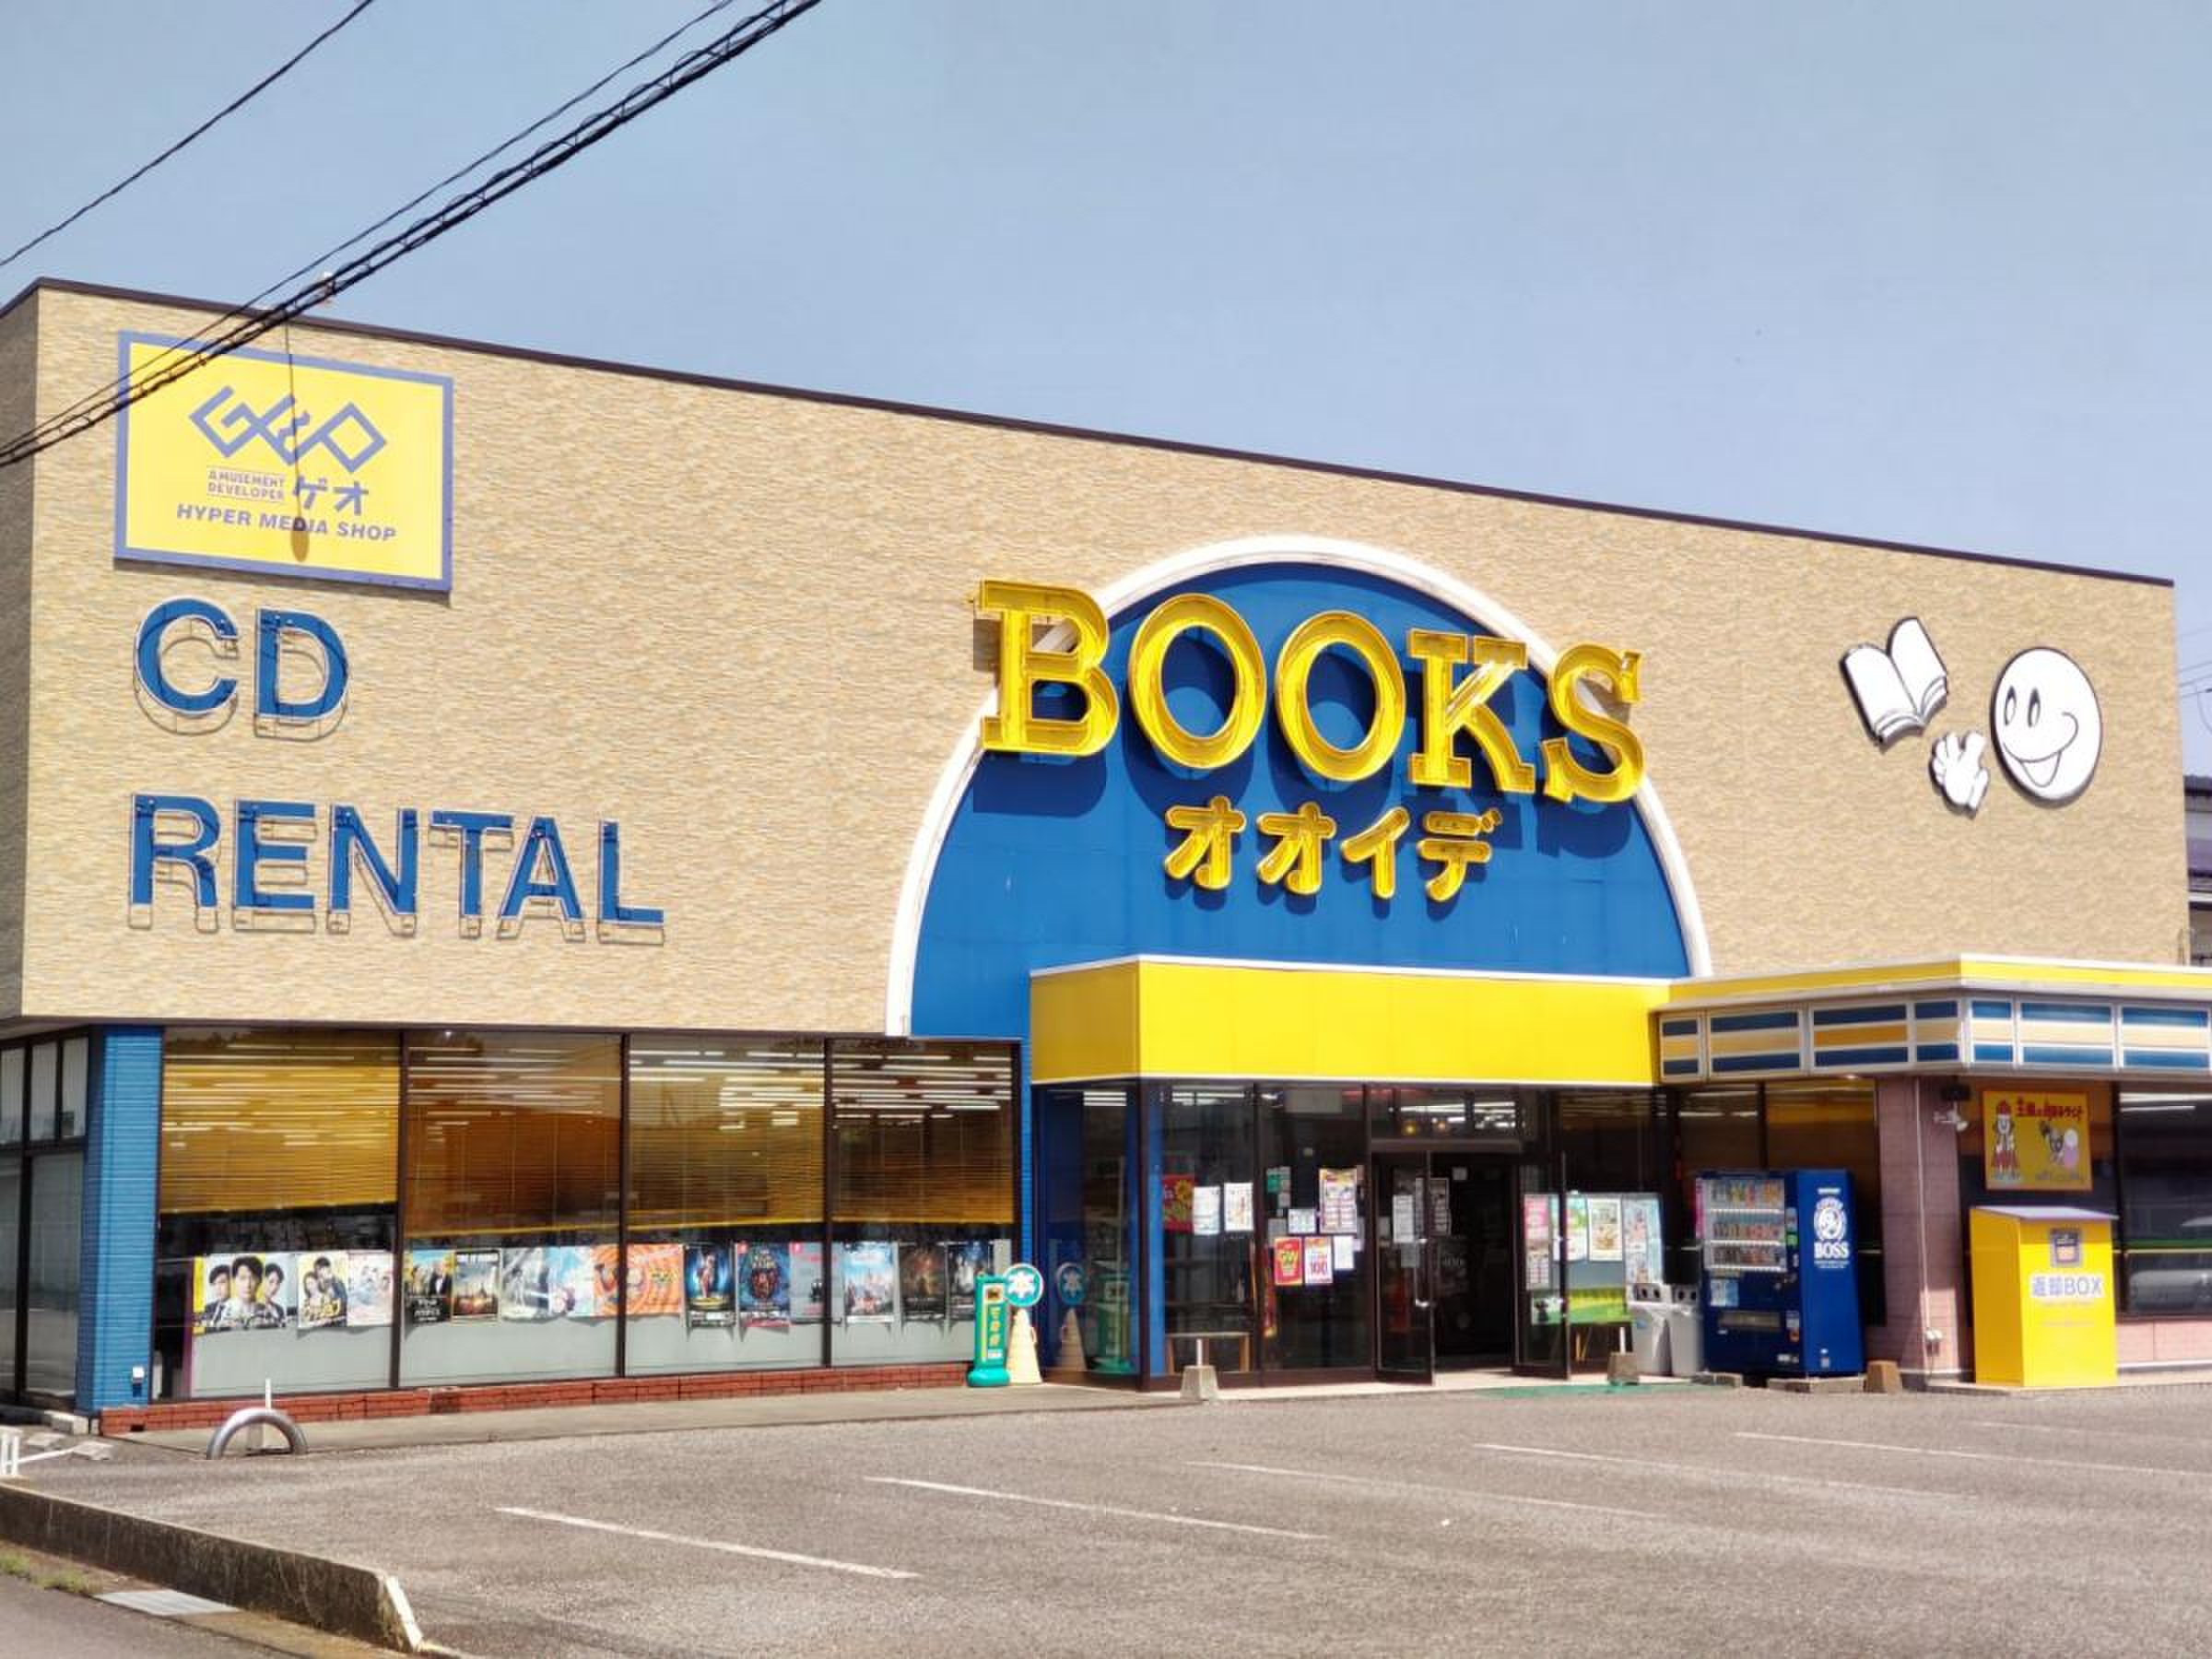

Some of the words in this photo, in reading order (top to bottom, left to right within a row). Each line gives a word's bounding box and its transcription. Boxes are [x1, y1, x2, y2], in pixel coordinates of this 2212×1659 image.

[208, 470, 285, 488] AMUSEMENT
[208, 482, 285, 500] DEVELOPER
[293, 475, 370, 516] ゲオ
[177, 503, 252, 526] HYPER
[259, 512, 328, 535] MEDIA
[336, 521, 396, 541] SHOP
[135, 596, 349, 721] CD
[978, 578, 1645, 805] BOOKS
[130, 793, 665, 926] RENTAL
[1164, 795, 1502, 902] オオイデ
[1814, 1241, 1849, 1259] BOSS
